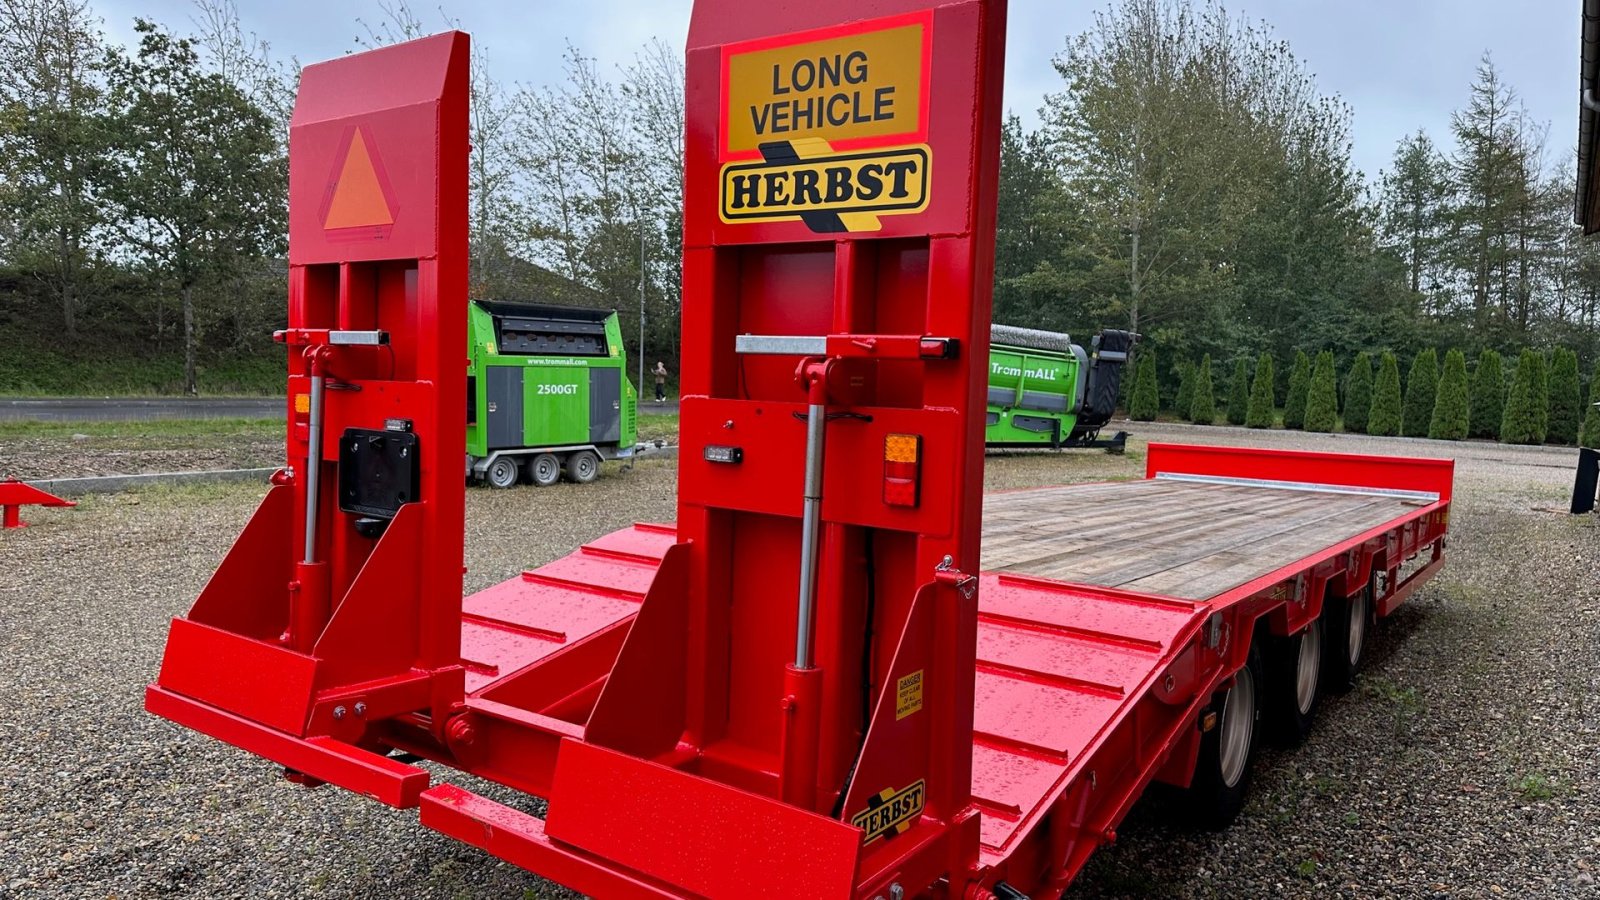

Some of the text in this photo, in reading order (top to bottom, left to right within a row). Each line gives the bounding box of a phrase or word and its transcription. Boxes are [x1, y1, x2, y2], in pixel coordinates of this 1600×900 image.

[773, 51, 868, 95] LONG
[751, 86, 895, 135] VEHICLE
[731, 160, 917, 209] HERBST
[527, 358, 588, 366] www.trommall.com
[537, 384, 578, 395] 2500GT
